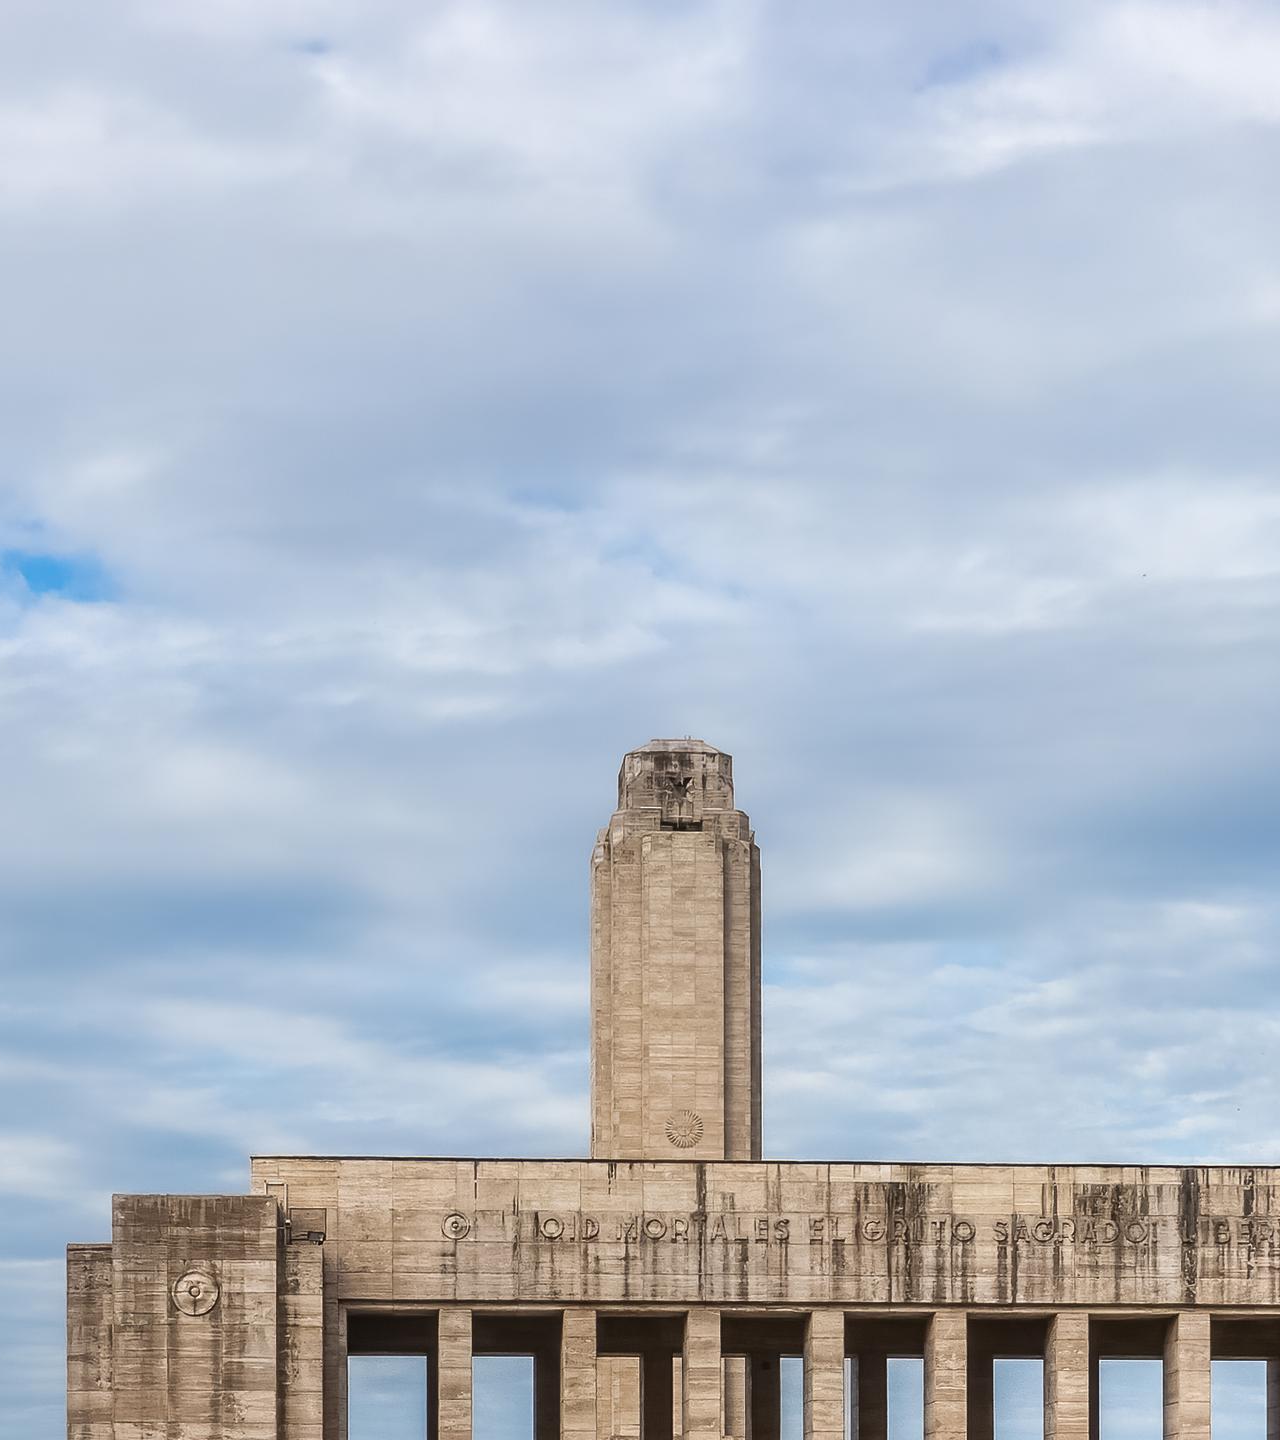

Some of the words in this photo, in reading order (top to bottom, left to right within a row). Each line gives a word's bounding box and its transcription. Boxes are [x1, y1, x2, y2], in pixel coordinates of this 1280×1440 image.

[616, 1215, 791, 1242] MORTALES
[808, 1217, 846, 1244] EL
[862, 1218, 977, 1243] GRITO
